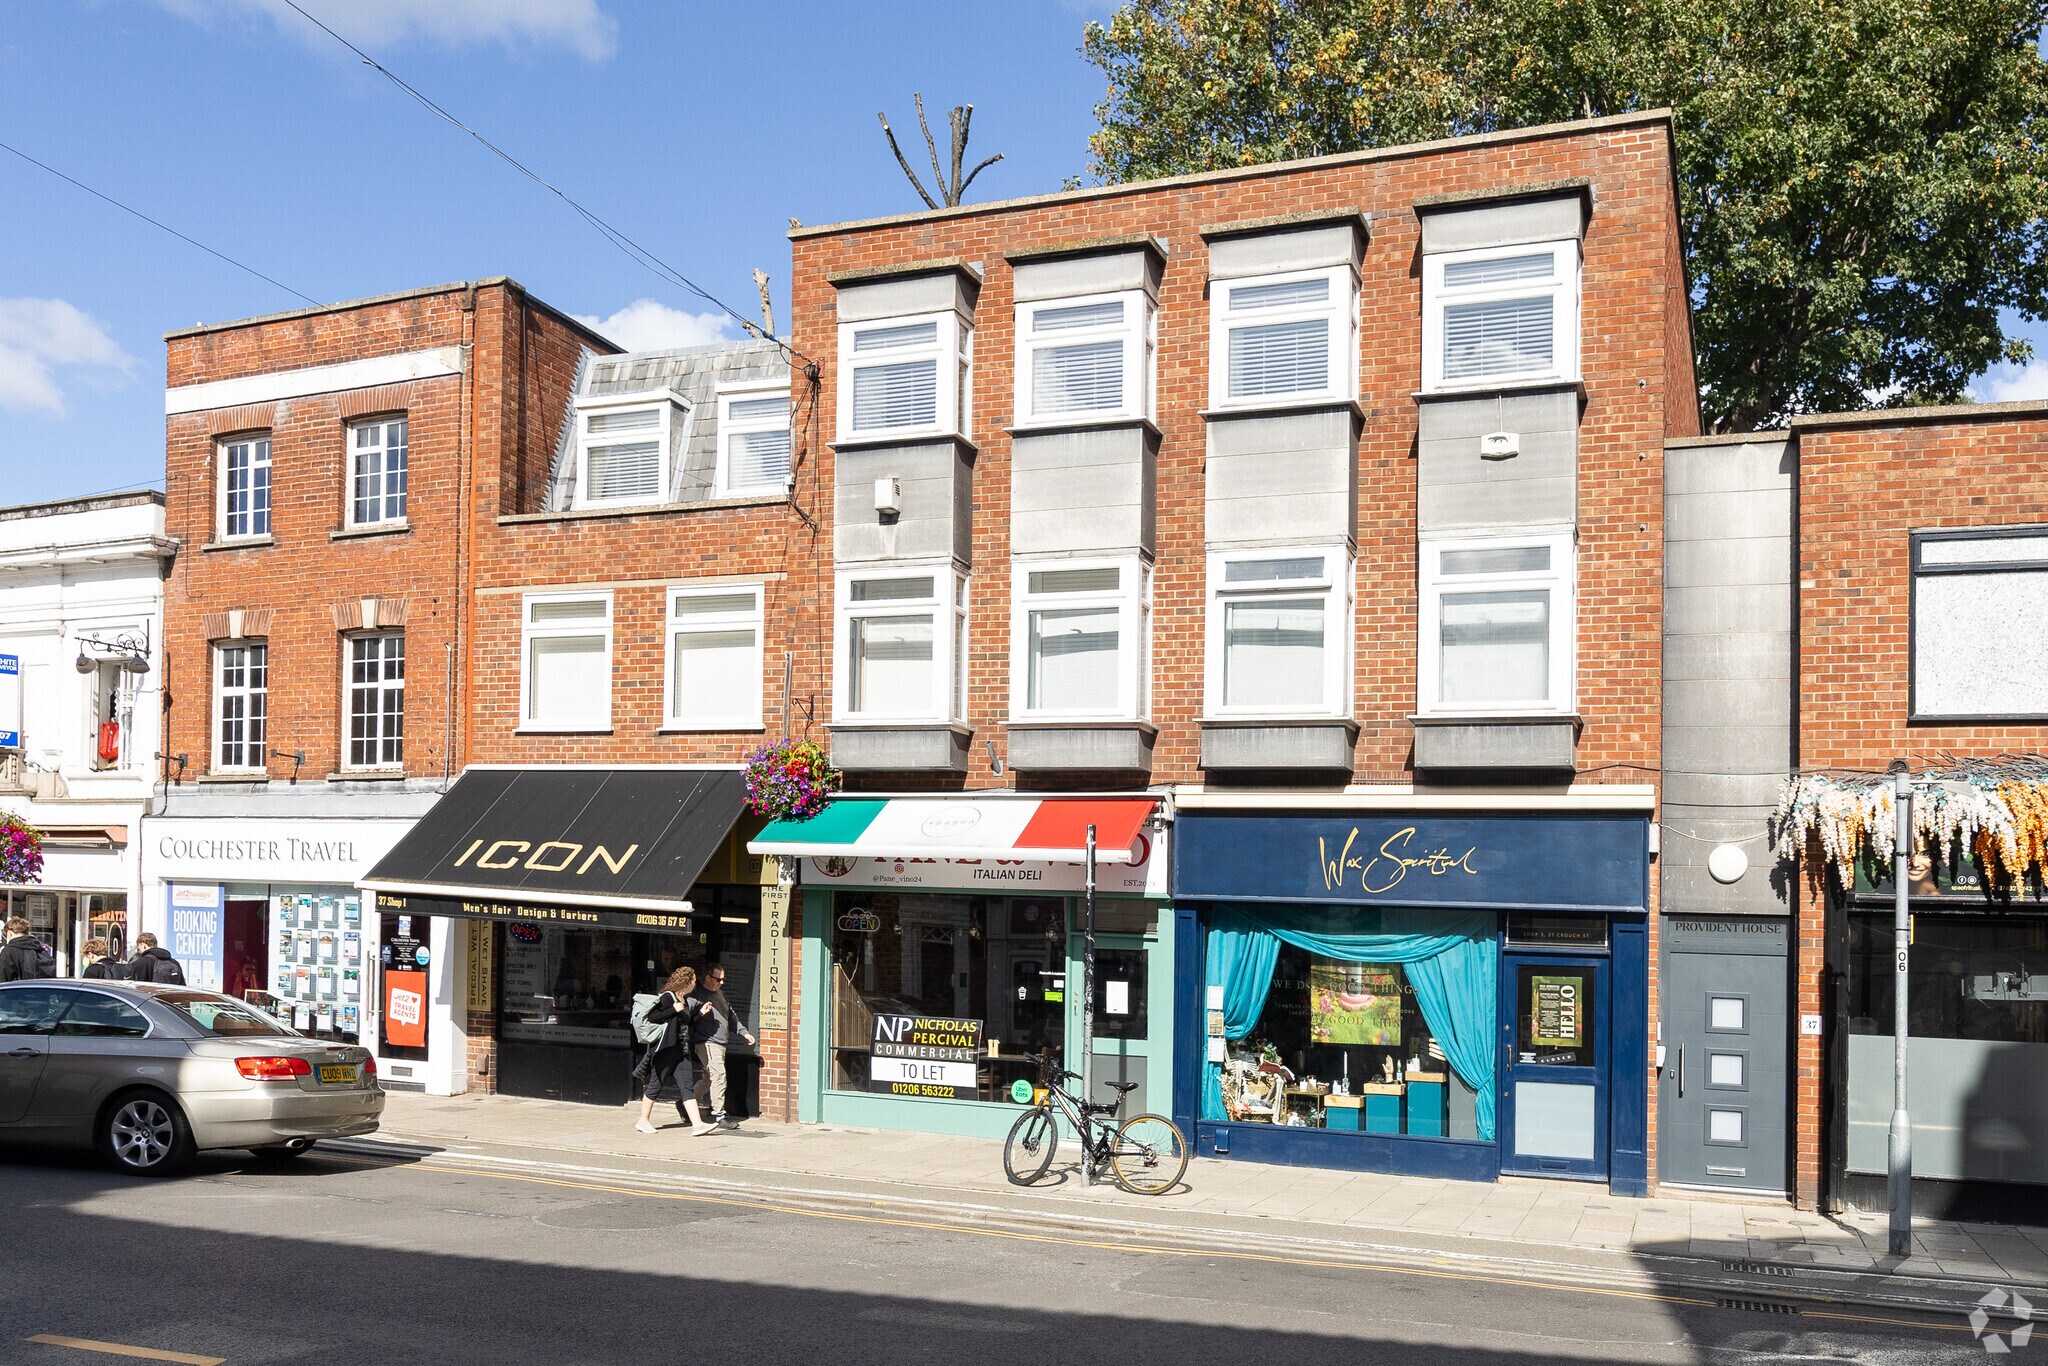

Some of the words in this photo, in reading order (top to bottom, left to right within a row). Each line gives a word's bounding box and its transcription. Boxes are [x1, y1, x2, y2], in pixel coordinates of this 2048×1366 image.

[453, 839, 639, 875] ICON
[1319, 827, 1363, 891] Wax
[1362, 827, 1477, 893] Spiritual
[872, 874, 922, 883] @Pane_vino24
[973, 869, 1015, 880] ITALIAN
[1019, 869, 1042, 881] DELI
[378, 896, 386, 906] 37
[387, 896, 402, 909] Shop
[463, 902, 489, 914] Men's
[492, 904, 512, 915] Hair
[517, 905, 548, 920] Design
[550, 909, 557, 918] &
[560, 909, 598, 922] Barbers
[636, 914, 658, 925] 01206
[173, 910, 217, 933] BOOKING
[845, 919, 875, 930] OPEN
[1675, 922, 1741, 932] PROVIDENT
[1742, 924, 1782, 934] HOUSE
[511, 924, 540, 939] OPEN
[176, 933, 214, 956] CENTRE
[769, 901, 779, 1003] TRADITIONAL
[1273, 979, 1291, 989] WE
[393, 1009, 416, 1020] AGENTS
[394, 1002, 416, 1013] TRAVEL
[1560, 985, 1575, 1038] HELLO
[875, 1015, 913, 1042] NP
[914, 1018, 977, 1033] NICHOLAS
[1805, 1020, 1818, 1029] 37
[912, 1032, 974, 1047] PERCIVAL
[876, 1044, 971, 1060] COMMERCIAL
[900, 1063, 917, 1078] TO
[922, 1065, 946, 1081] LET
[892, 1082, 919, 1095] 01206
[921, 1084, 955, 1098] 563222
